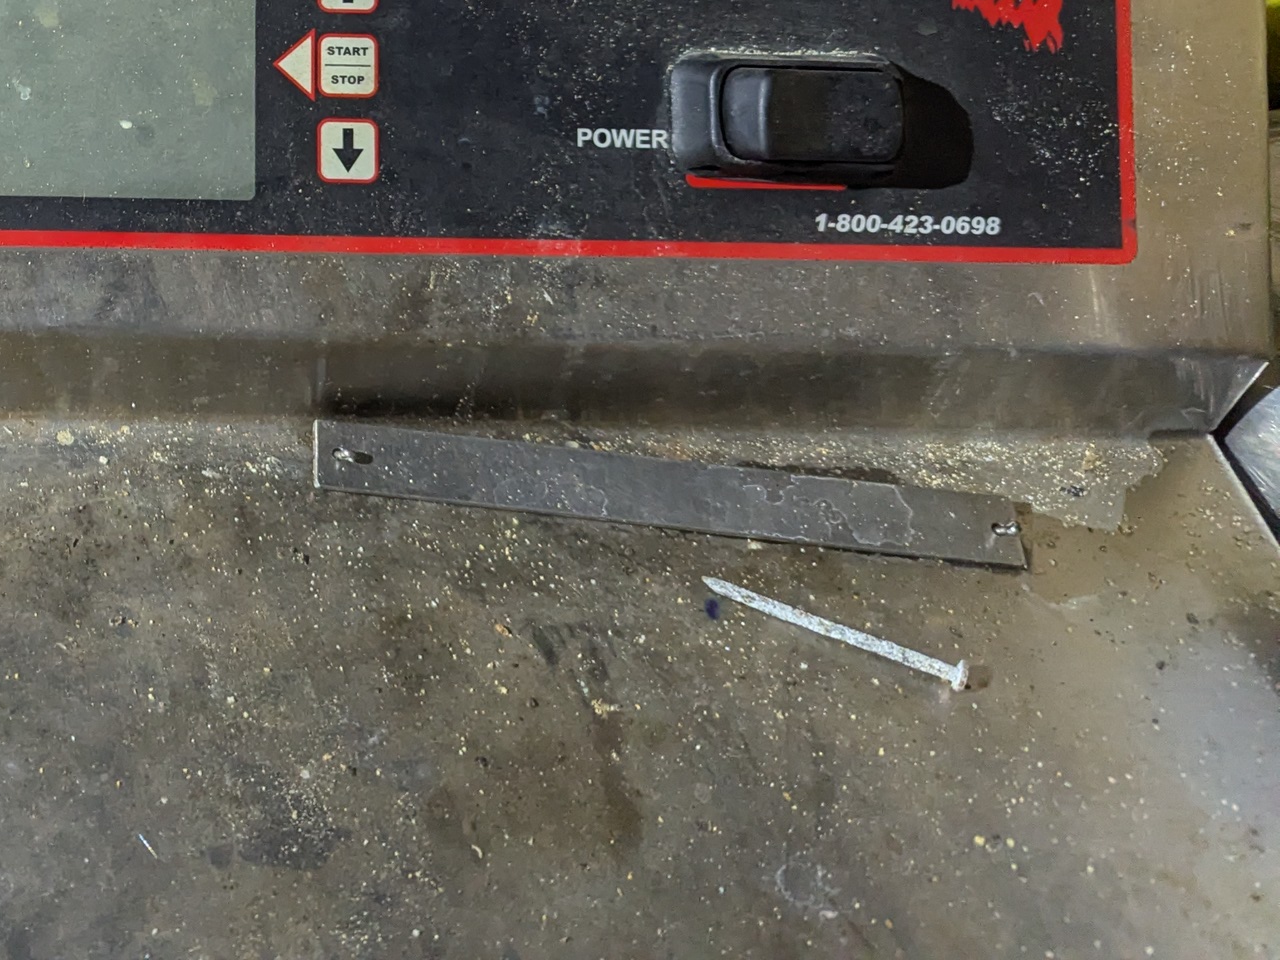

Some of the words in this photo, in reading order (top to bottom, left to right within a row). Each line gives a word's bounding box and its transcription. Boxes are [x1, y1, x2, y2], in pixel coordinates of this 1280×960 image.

[327, 46, 369, 57] START
[331, 75, 365, 85] STOP
[576, 127, 669, 149] POWER
[814, 213, 1001, 235] 1-800-423-0698
